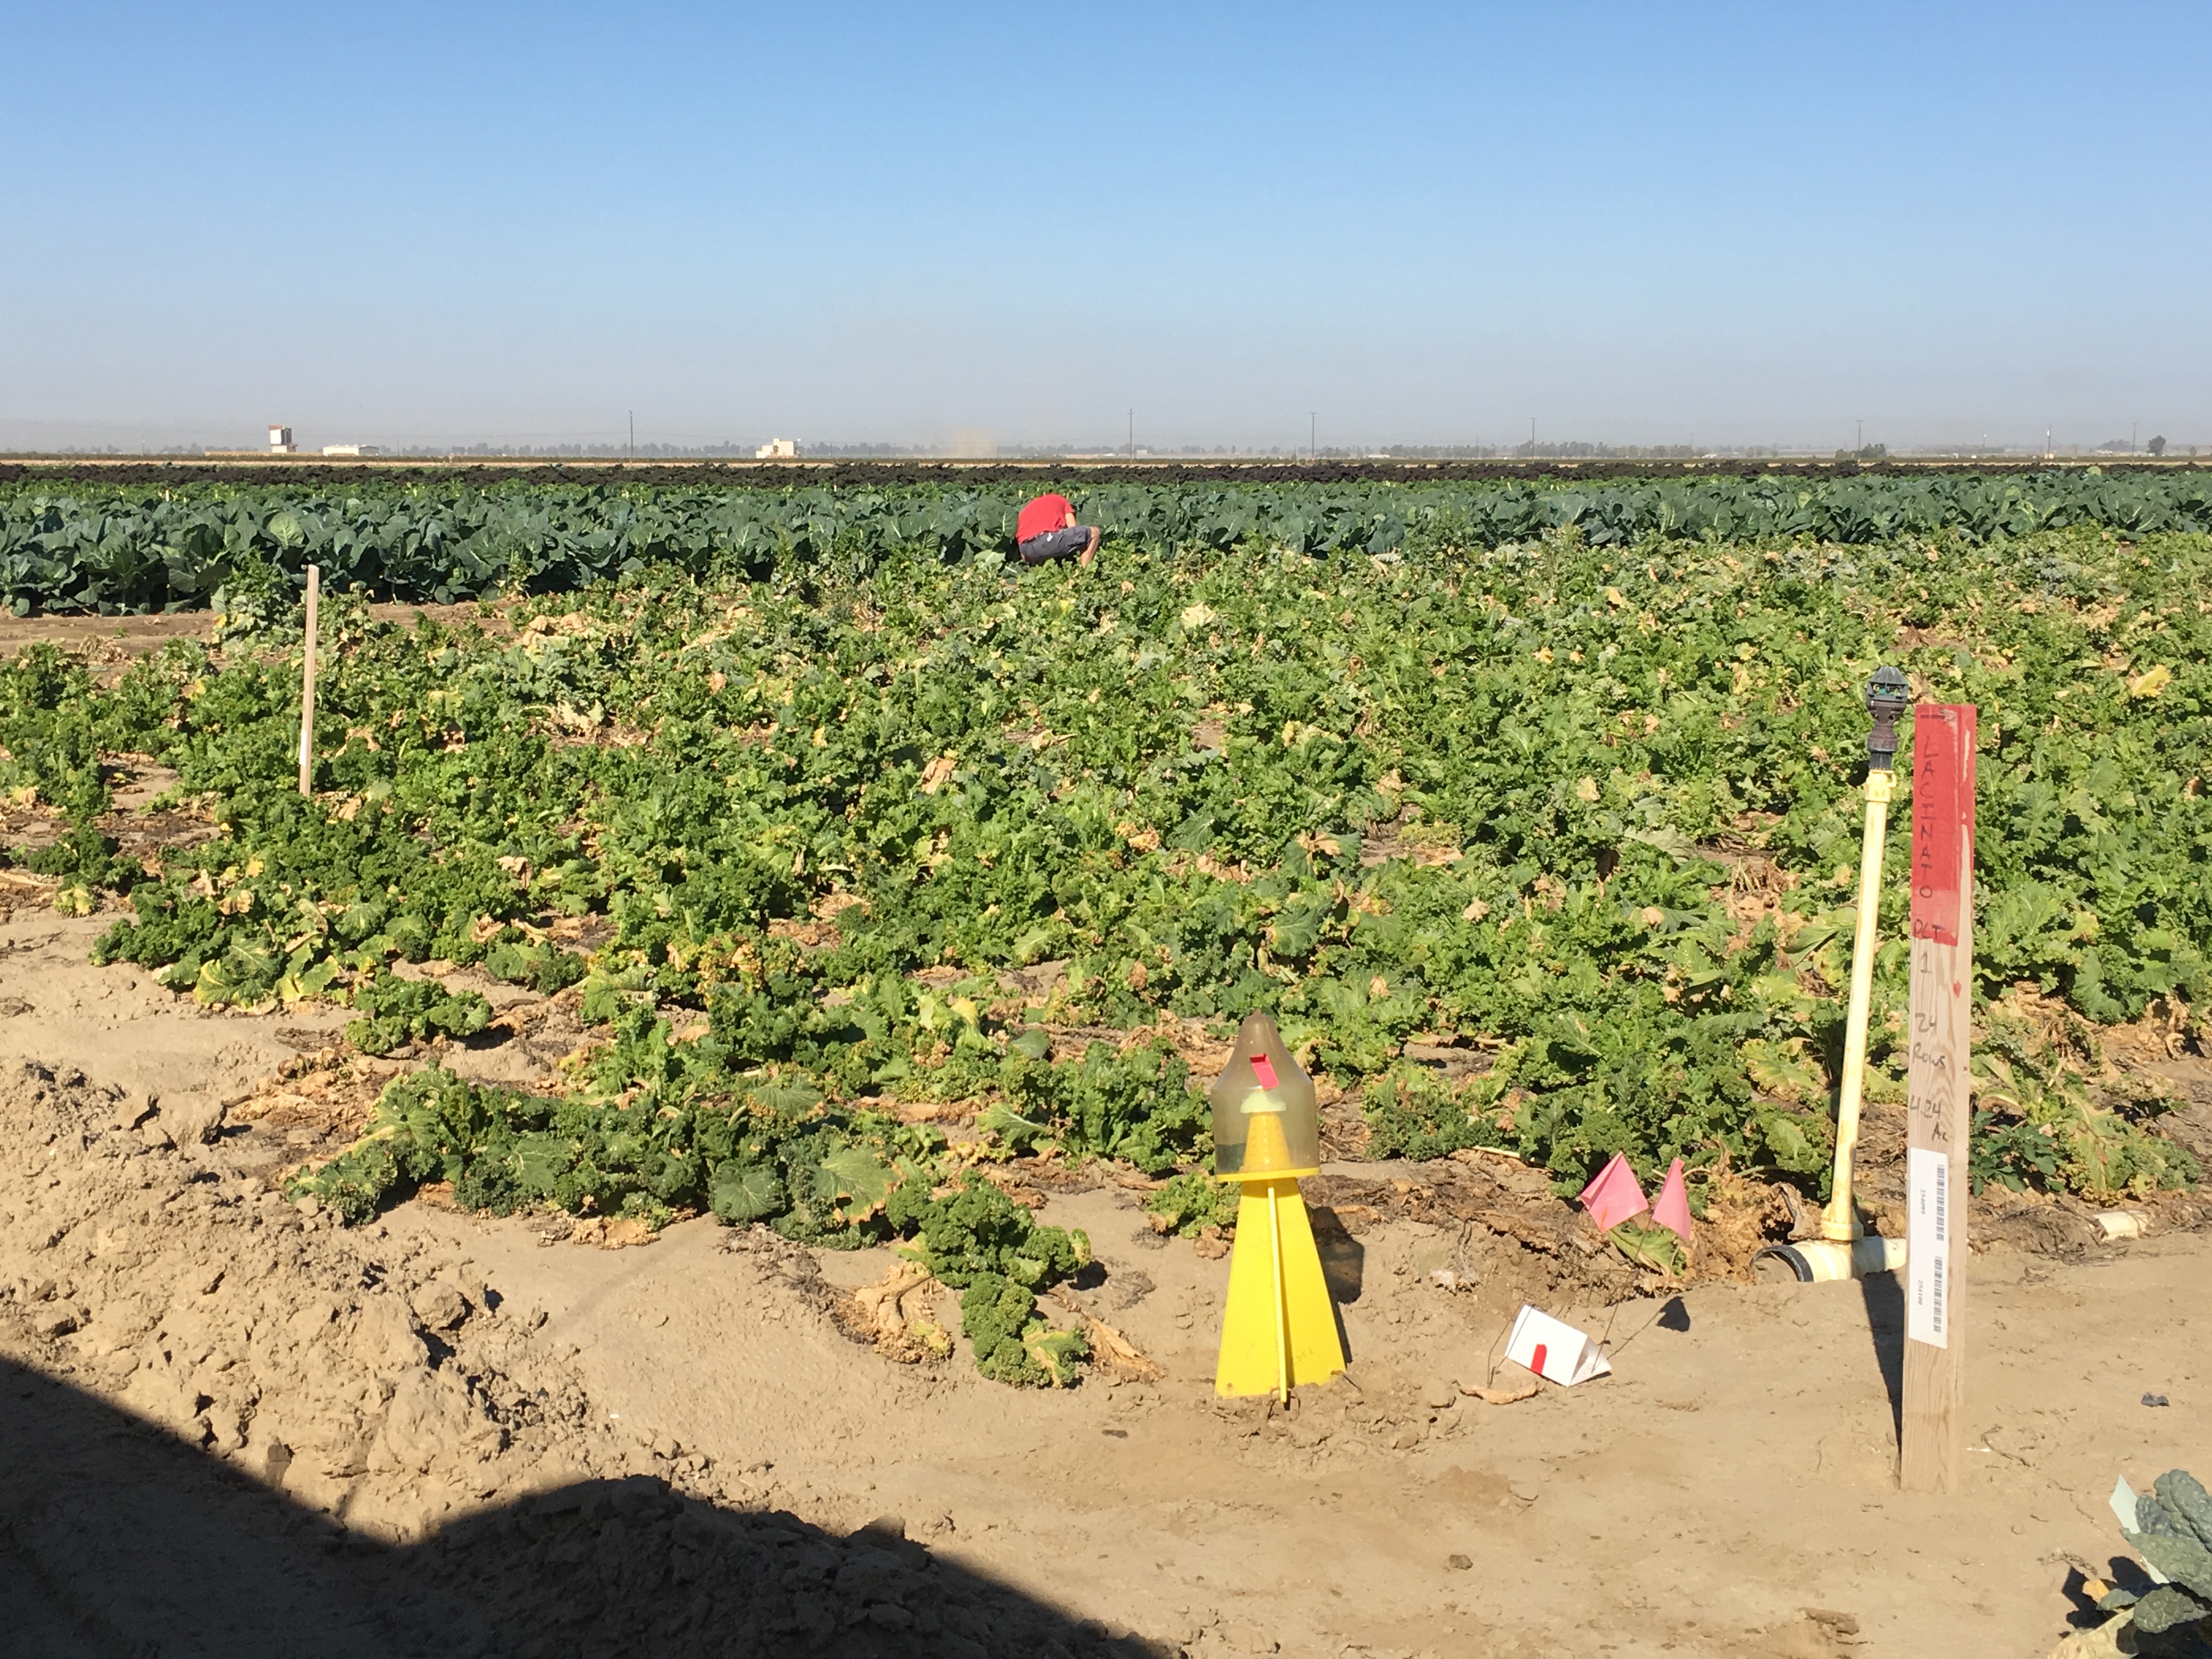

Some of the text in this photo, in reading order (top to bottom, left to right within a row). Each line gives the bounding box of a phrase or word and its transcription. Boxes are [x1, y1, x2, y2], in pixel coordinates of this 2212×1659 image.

[1918, 735, 1939, 899] LACINATO
[1920, 950, 1933, 974] 1
[1915, 1012, 1937, 1033] 24
